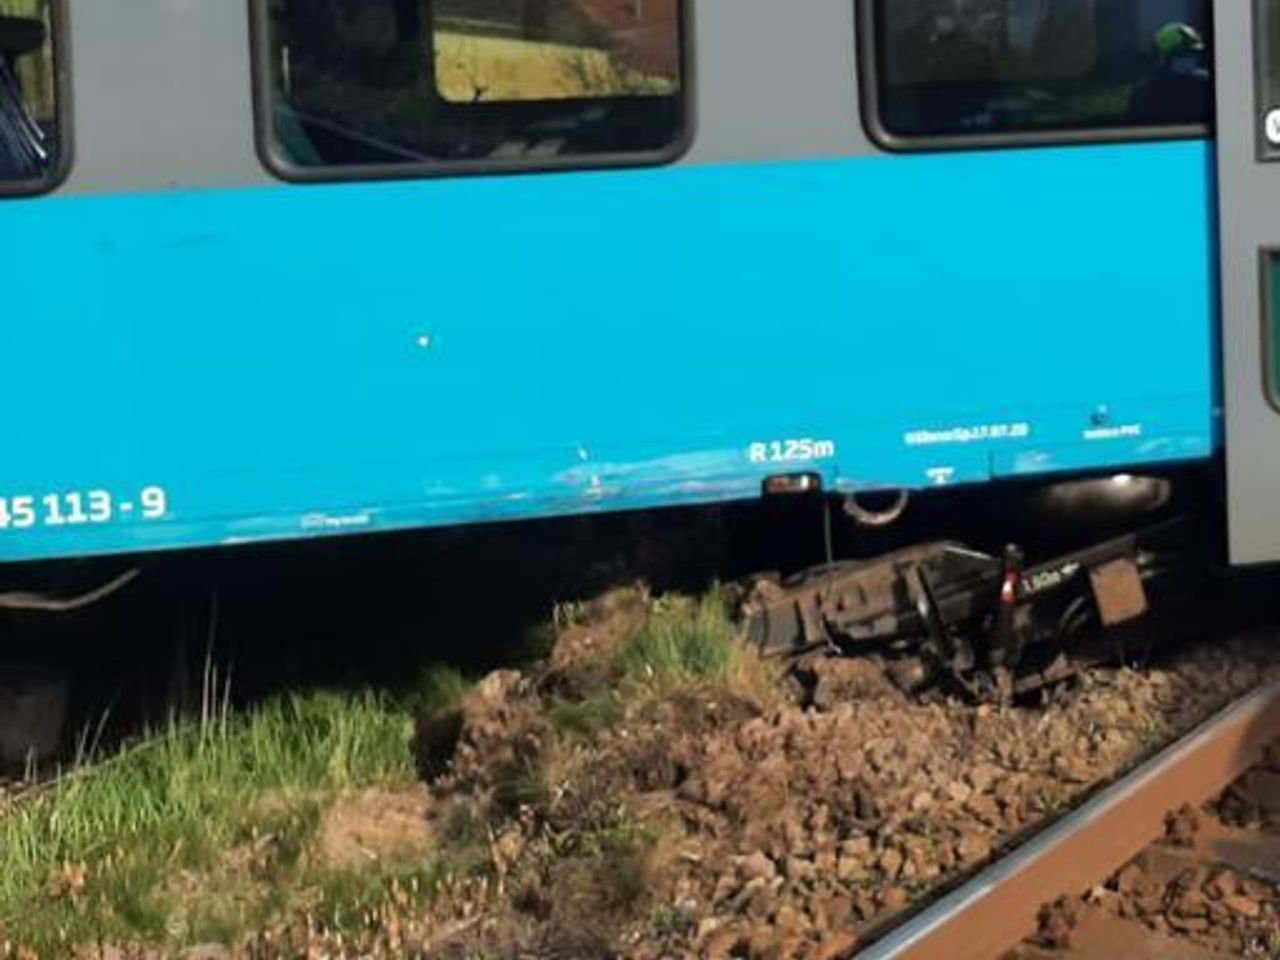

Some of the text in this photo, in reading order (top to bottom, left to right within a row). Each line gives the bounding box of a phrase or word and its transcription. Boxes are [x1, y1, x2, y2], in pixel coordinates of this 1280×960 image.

[750, 442, 767, 462] R
[42, 490, 111, 525] 113
[140, 485, 166, 518] 9
